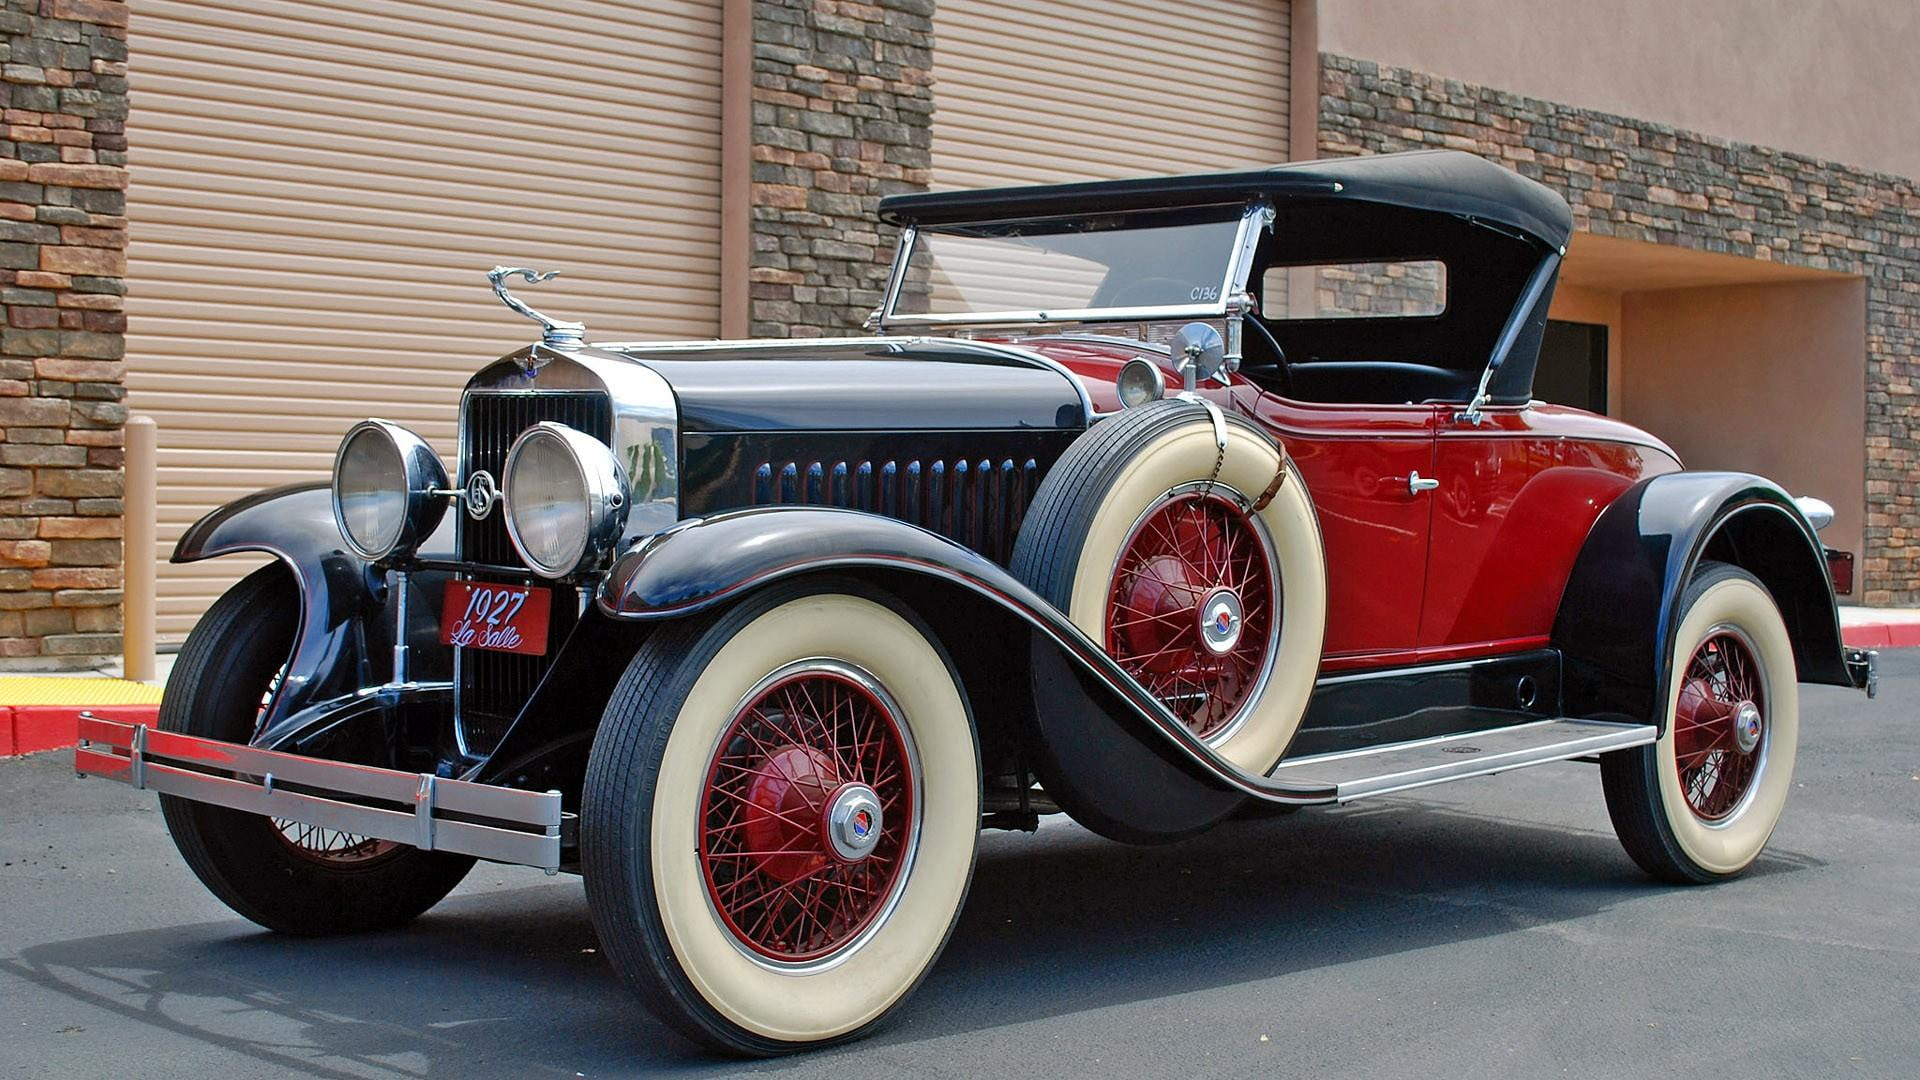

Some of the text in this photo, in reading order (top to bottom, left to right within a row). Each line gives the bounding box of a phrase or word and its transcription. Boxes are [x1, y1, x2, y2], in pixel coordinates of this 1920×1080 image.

[1190, 286, 1218, 300] C136
[464, 588, 525, 625] 1927
[450, 620, 523, 649] La Salle
